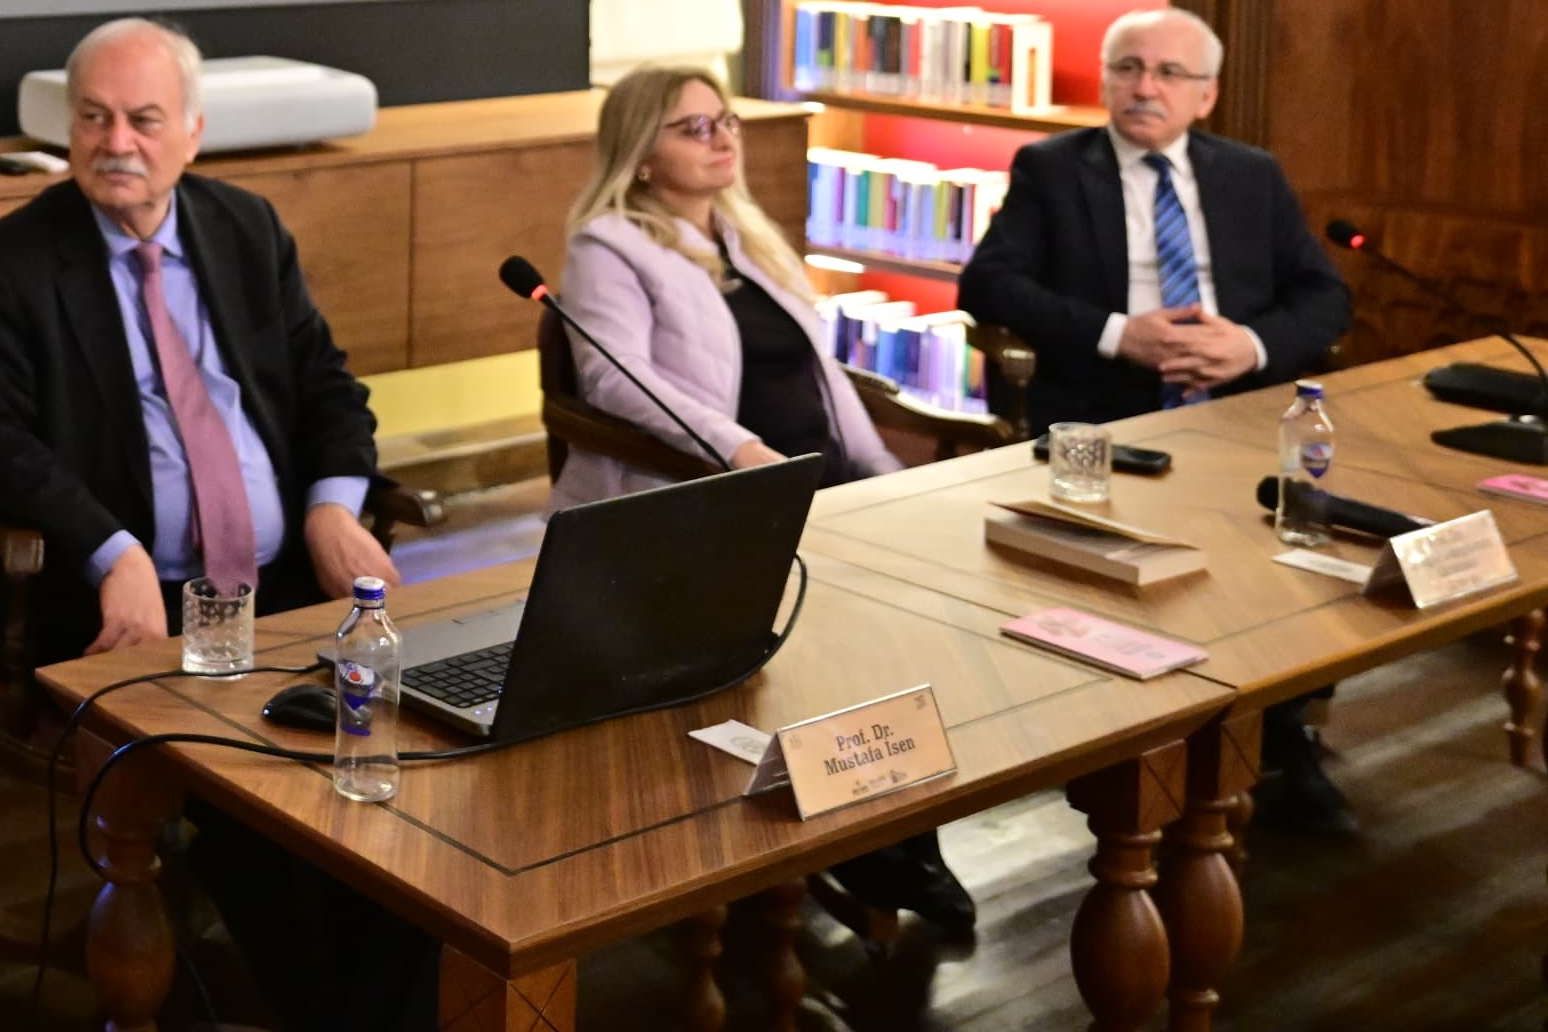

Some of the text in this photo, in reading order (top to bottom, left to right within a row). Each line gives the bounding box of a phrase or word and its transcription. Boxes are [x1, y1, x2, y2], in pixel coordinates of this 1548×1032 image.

[836, 723, 894, 752] Prof. Dr.
[824, 746, 884, 776] Mustafa
